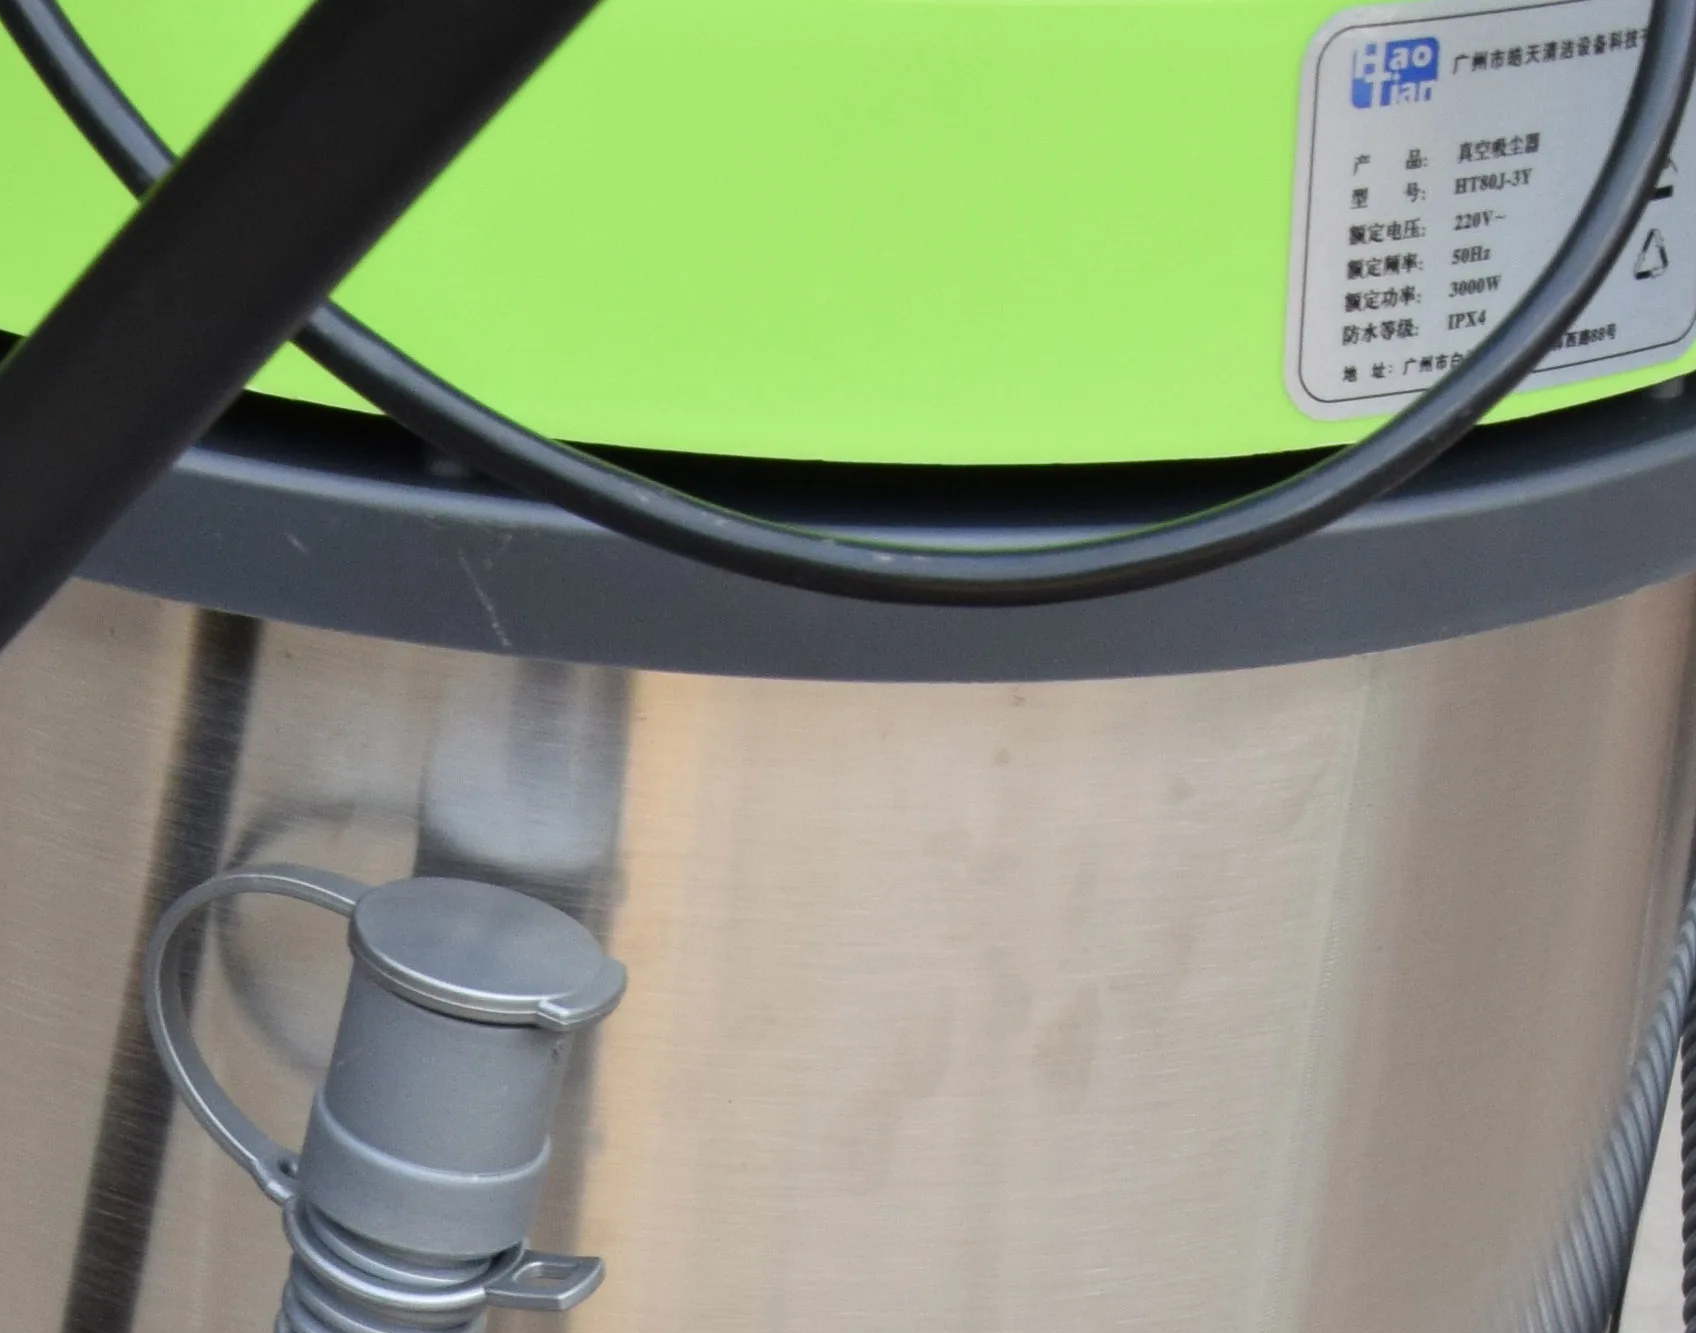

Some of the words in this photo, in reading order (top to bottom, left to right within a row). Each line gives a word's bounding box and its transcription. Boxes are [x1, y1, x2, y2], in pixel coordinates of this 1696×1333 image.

[1353, 154, 1371, 176] 产
[1457, 132, 1540, 164] 真空吸尘器
[1350, 188, 1369, 209] 型
[1454, 168, 1532, 195] HT80J-3Y
[1348, 217, 1426, 245] 额定电压：
[1347, 252, 1424, 280] 额定频率：
[1451, 245, 1492, 265] 50Hz
[1345, 285, 1422, 313] 额定功率：
[1449, 275, 1502, 298] 3000W
[1342, 318, 1419, 346] 防水等级：
[1447, 309, 1487, 330] IPX4
